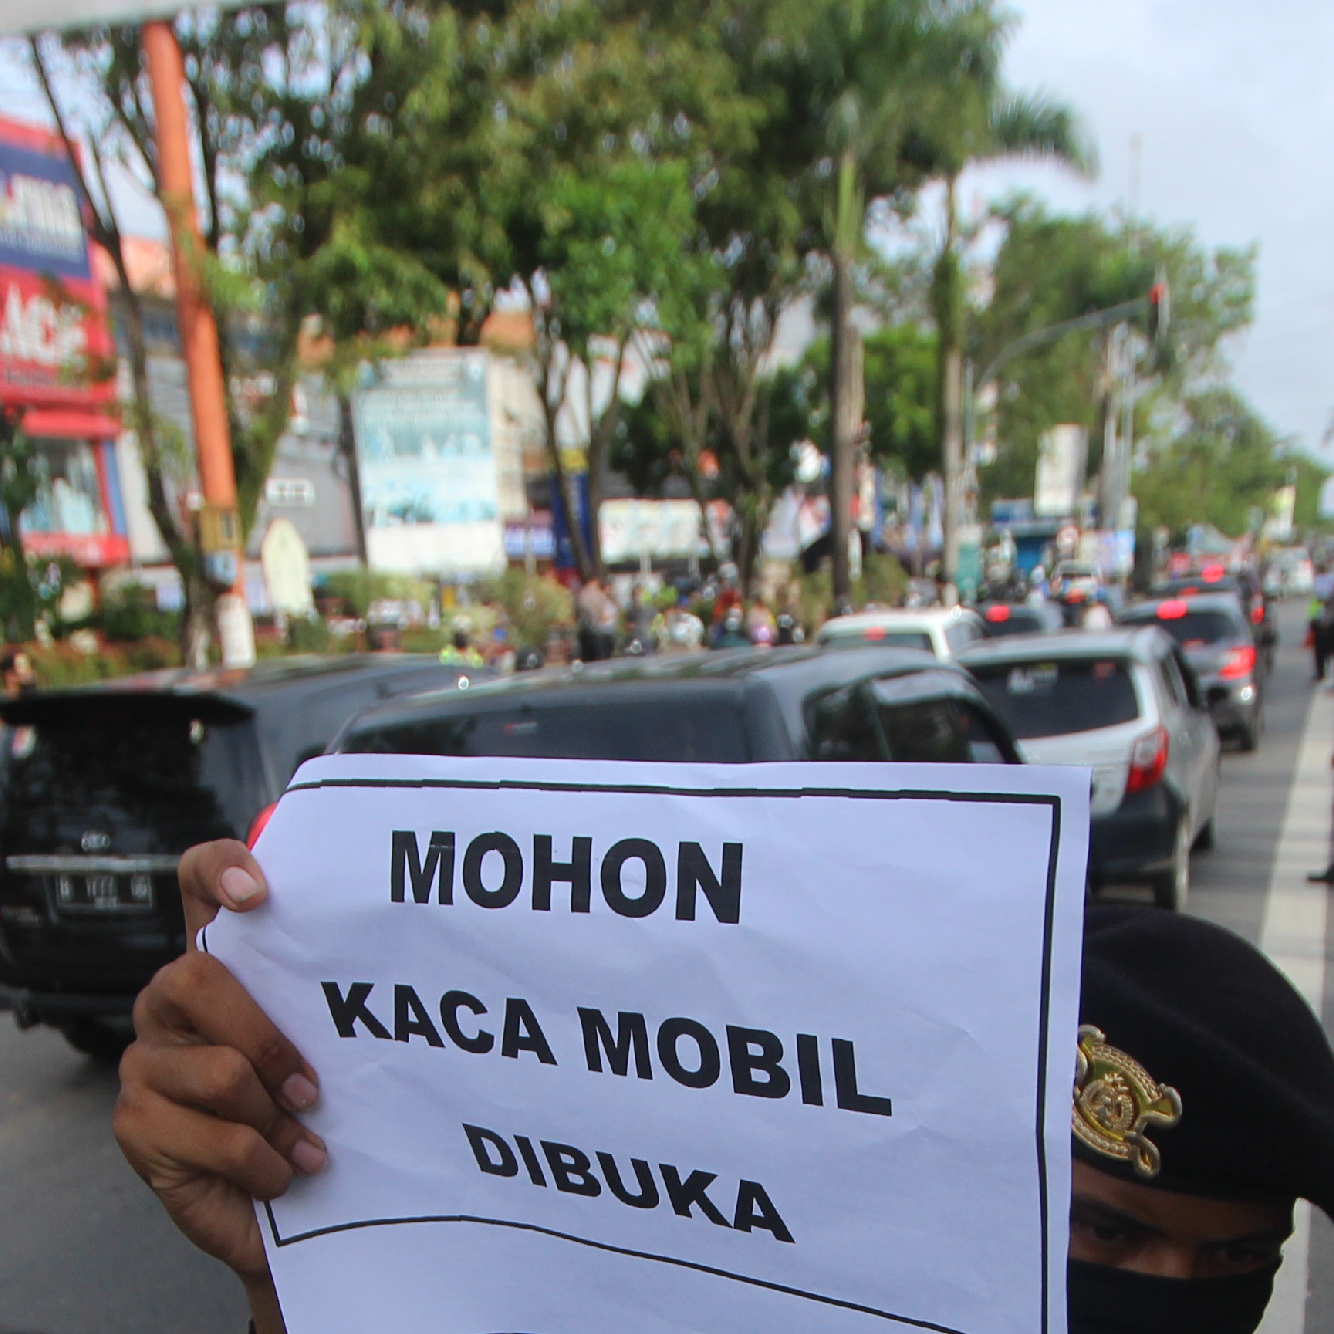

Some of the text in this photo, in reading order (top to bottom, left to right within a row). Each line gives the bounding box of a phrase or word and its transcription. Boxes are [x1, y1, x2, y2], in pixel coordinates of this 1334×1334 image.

[391, 831, 743, 924] MOHON
[321, 982, 892, 1116] KACA MOBIL
[463, 1124, 795, 1243] DIBUKA
